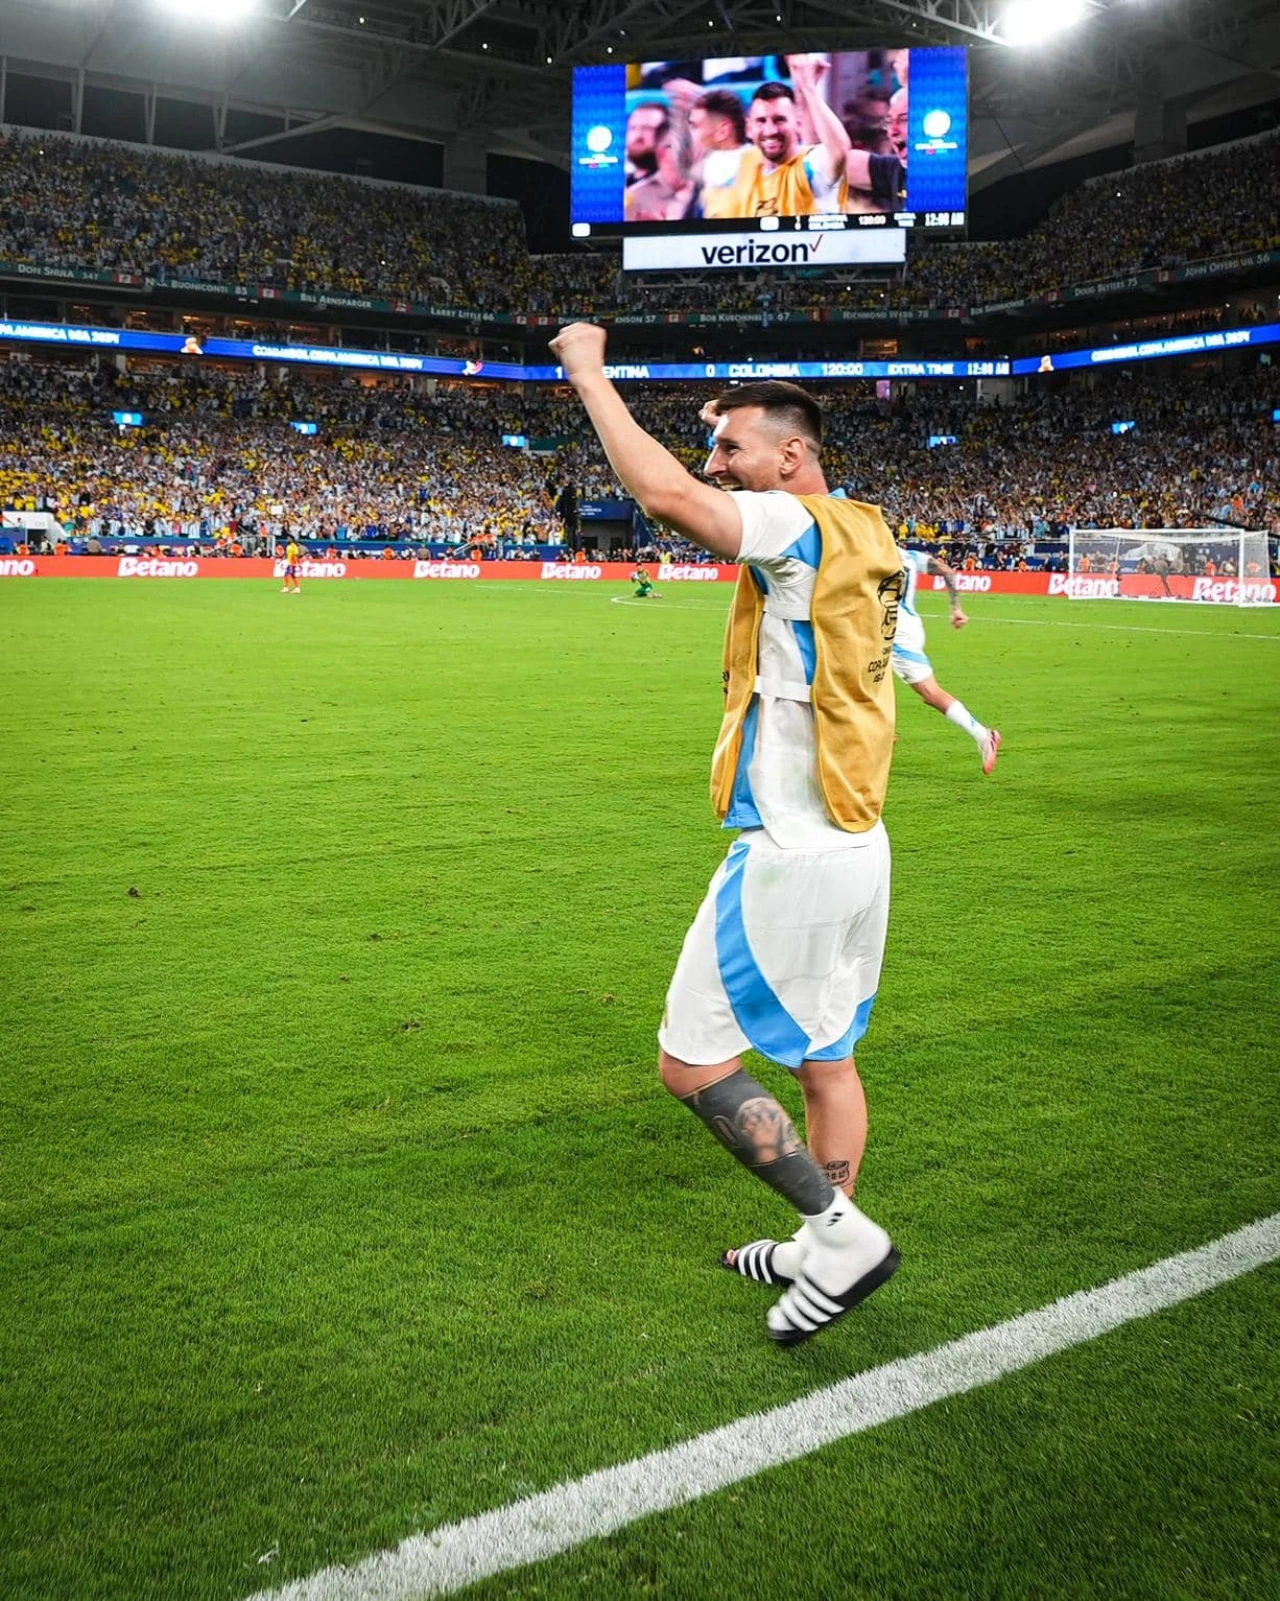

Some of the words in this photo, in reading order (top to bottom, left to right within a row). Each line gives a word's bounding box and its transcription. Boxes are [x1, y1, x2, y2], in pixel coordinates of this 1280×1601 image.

[701, 238, 809, 265] verizon
[1256, 252, 1270, 264] 56
[18, 264, 41, 275] DON
[44, 266, 74, 278] SHULA
[171, 280, 228, 293] BUONICONTI
[300, 293, 317, 303] BILL
[430, 307, 456, 317] LARRY
[458, 310, 481, 320] LITTLE
[777, 312, 791, 321] 67
[602, 365, 649, 379] ENTINA
[705, 363, 716, 378] 0
[728, 363, 800, 378] COLOMBIA
[821, 362, 864, 376] 120:00
[887, 362, 925, 375] EXTRA
[926, 362, 954, 375] TIME
[117, 557, 199, 577] Betano
[413, 561, 480, 578] Betano
[541, 562, 602, 580] Betano
[657, 563, 718, 581] Betano
[933, 574, 991, 592] Btano
[1048, 574, 1119, 597] Betano
[1192, 577, 1277, 603] Betano
